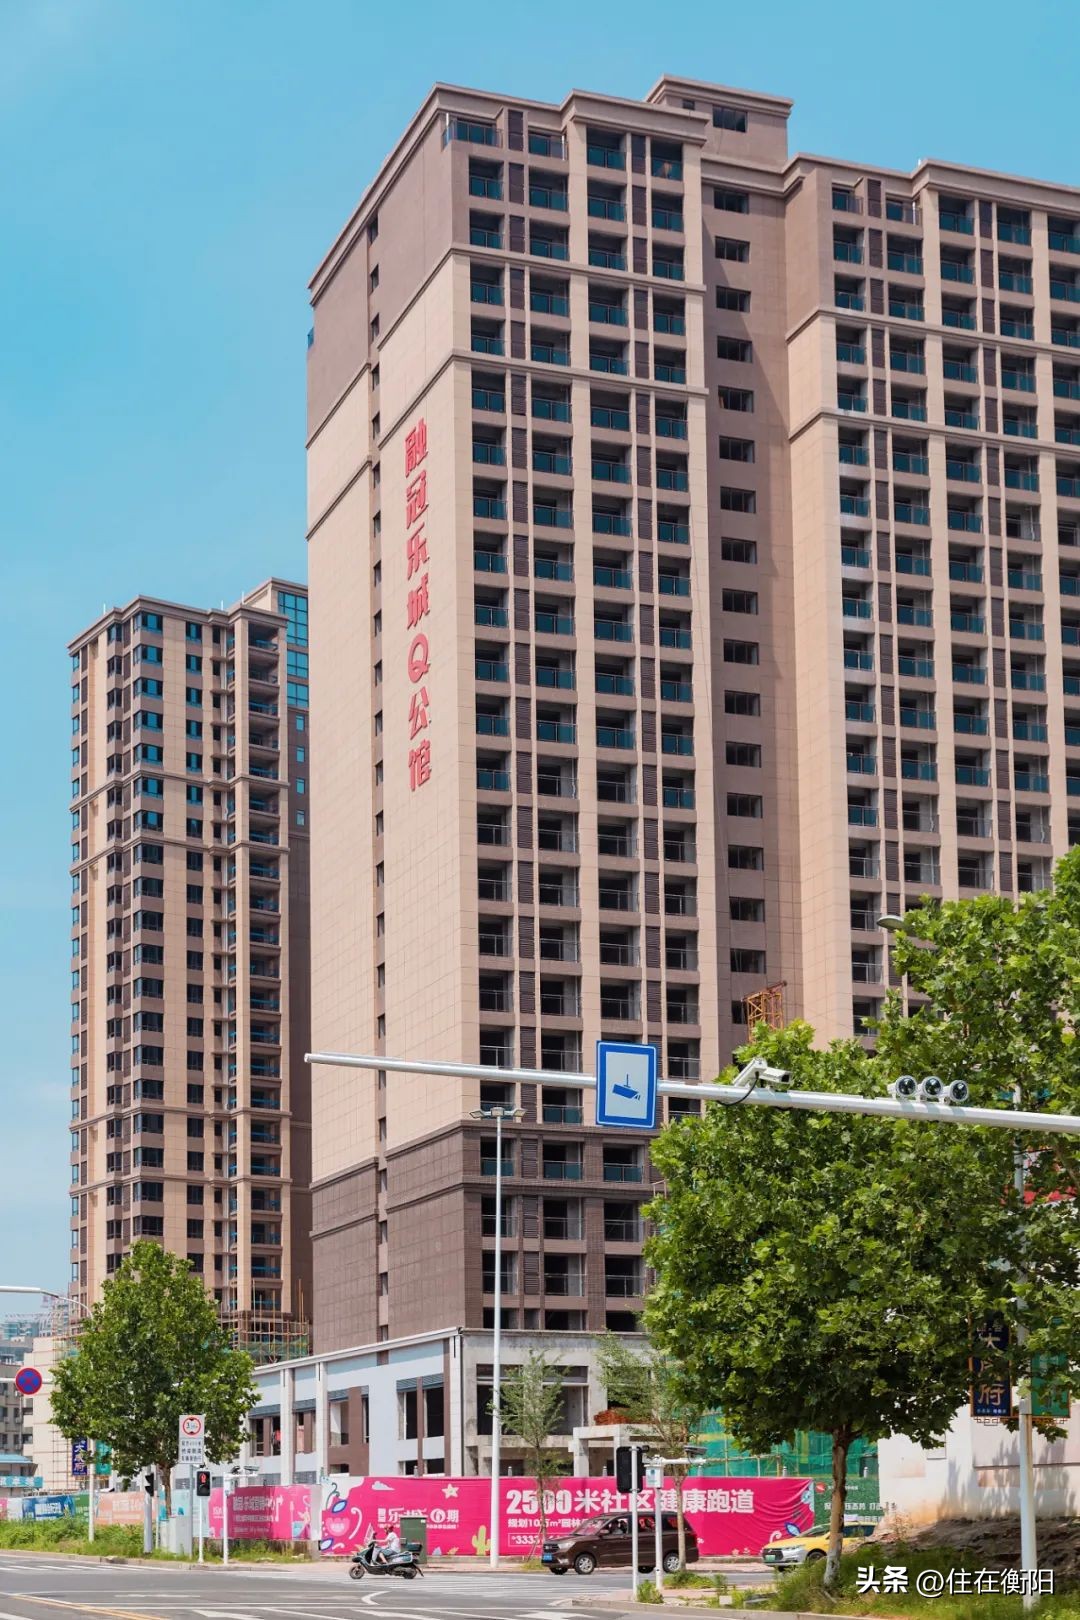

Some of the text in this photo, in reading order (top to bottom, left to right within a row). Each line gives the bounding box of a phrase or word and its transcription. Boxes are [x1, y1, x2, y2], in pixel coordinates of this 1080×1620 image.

[404, 417, 431, 792] 融冠乐城Q公馆
[976, 1333, 1006, 1405] 大府
